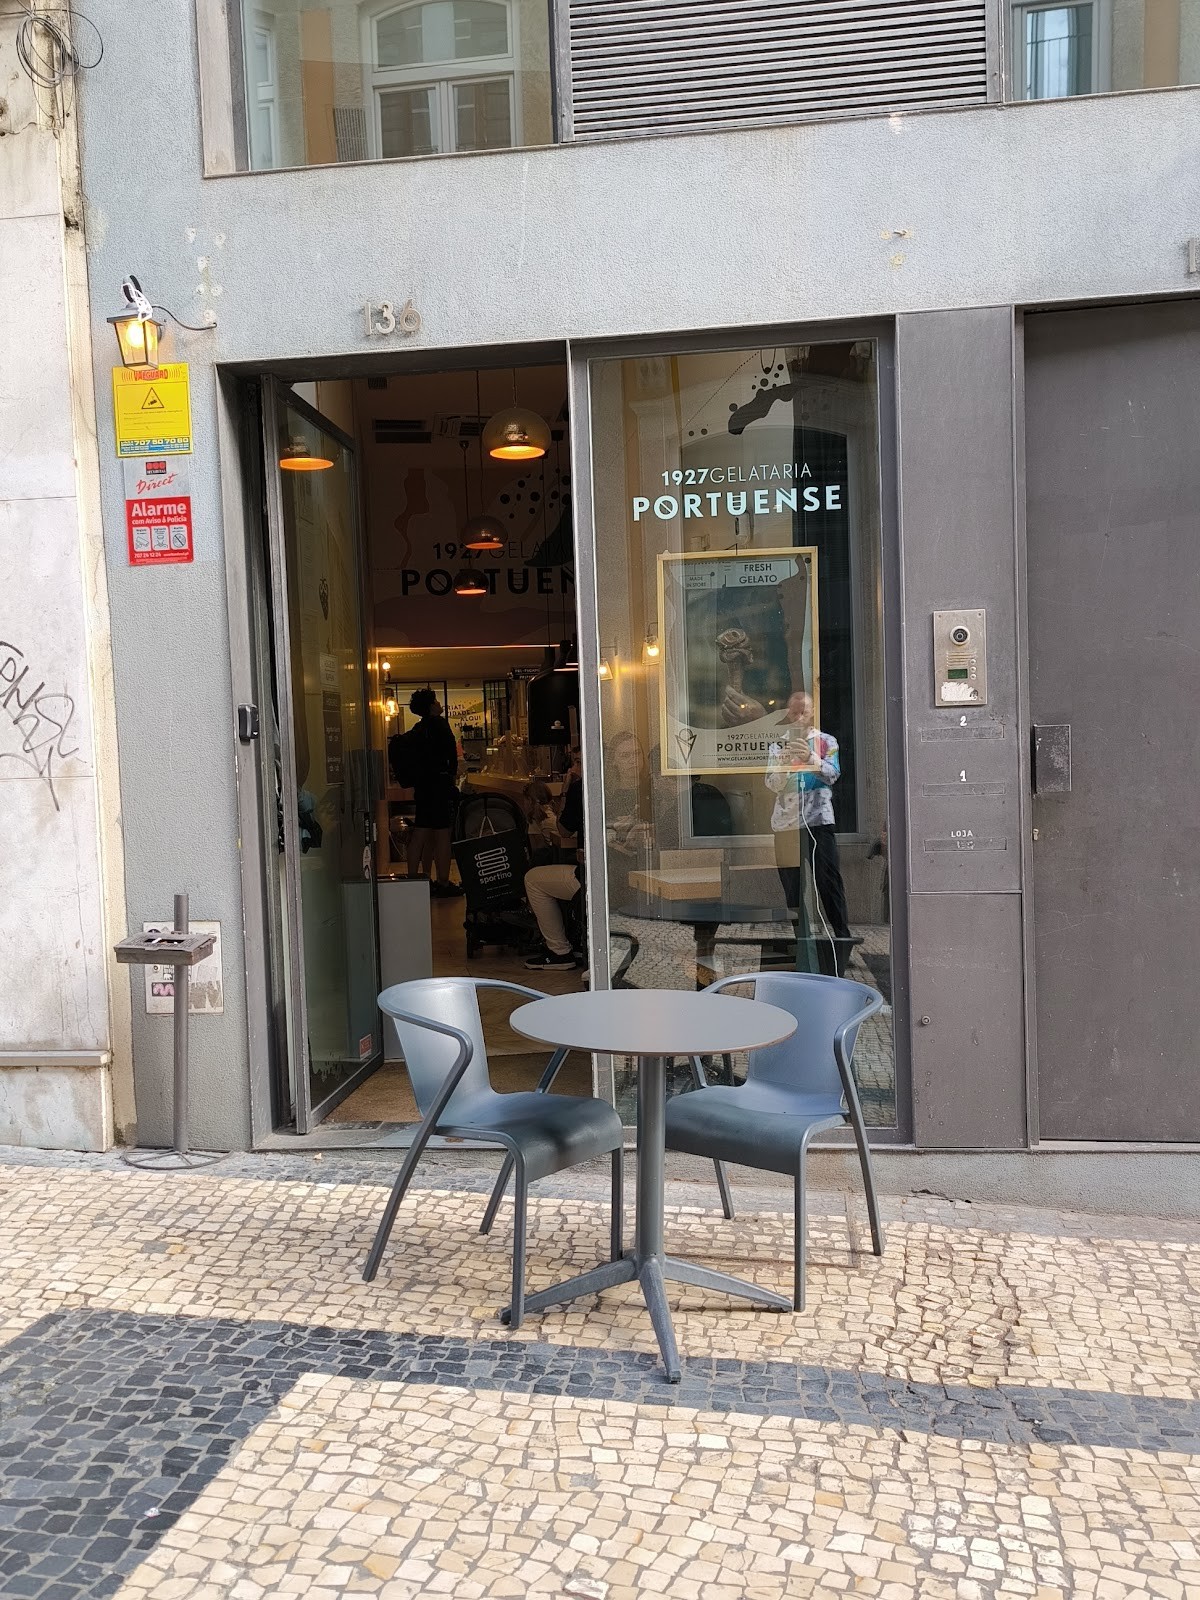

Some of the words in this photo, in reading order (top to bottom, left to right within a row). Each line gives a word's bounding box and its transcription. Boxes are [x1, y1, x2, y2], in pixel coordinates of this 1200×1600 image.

[364, 299, 422, 336] 136
[131, 502, 187, 517] Alarme
[632, 485, 842, 522] PORTUENSE
[145, 516, 162, 524] Aviso
[744, 563, 772, 572] FRESH
[739, 574, 778, 584] GELATO
[959, 715, 968, 727] 2
[716, 741, 791, 752] PORTUENSE
[959, 769, 967, 782] 1
[951, 830, 974, 838] LOJA
[479, 871, 512, 884] sportino
